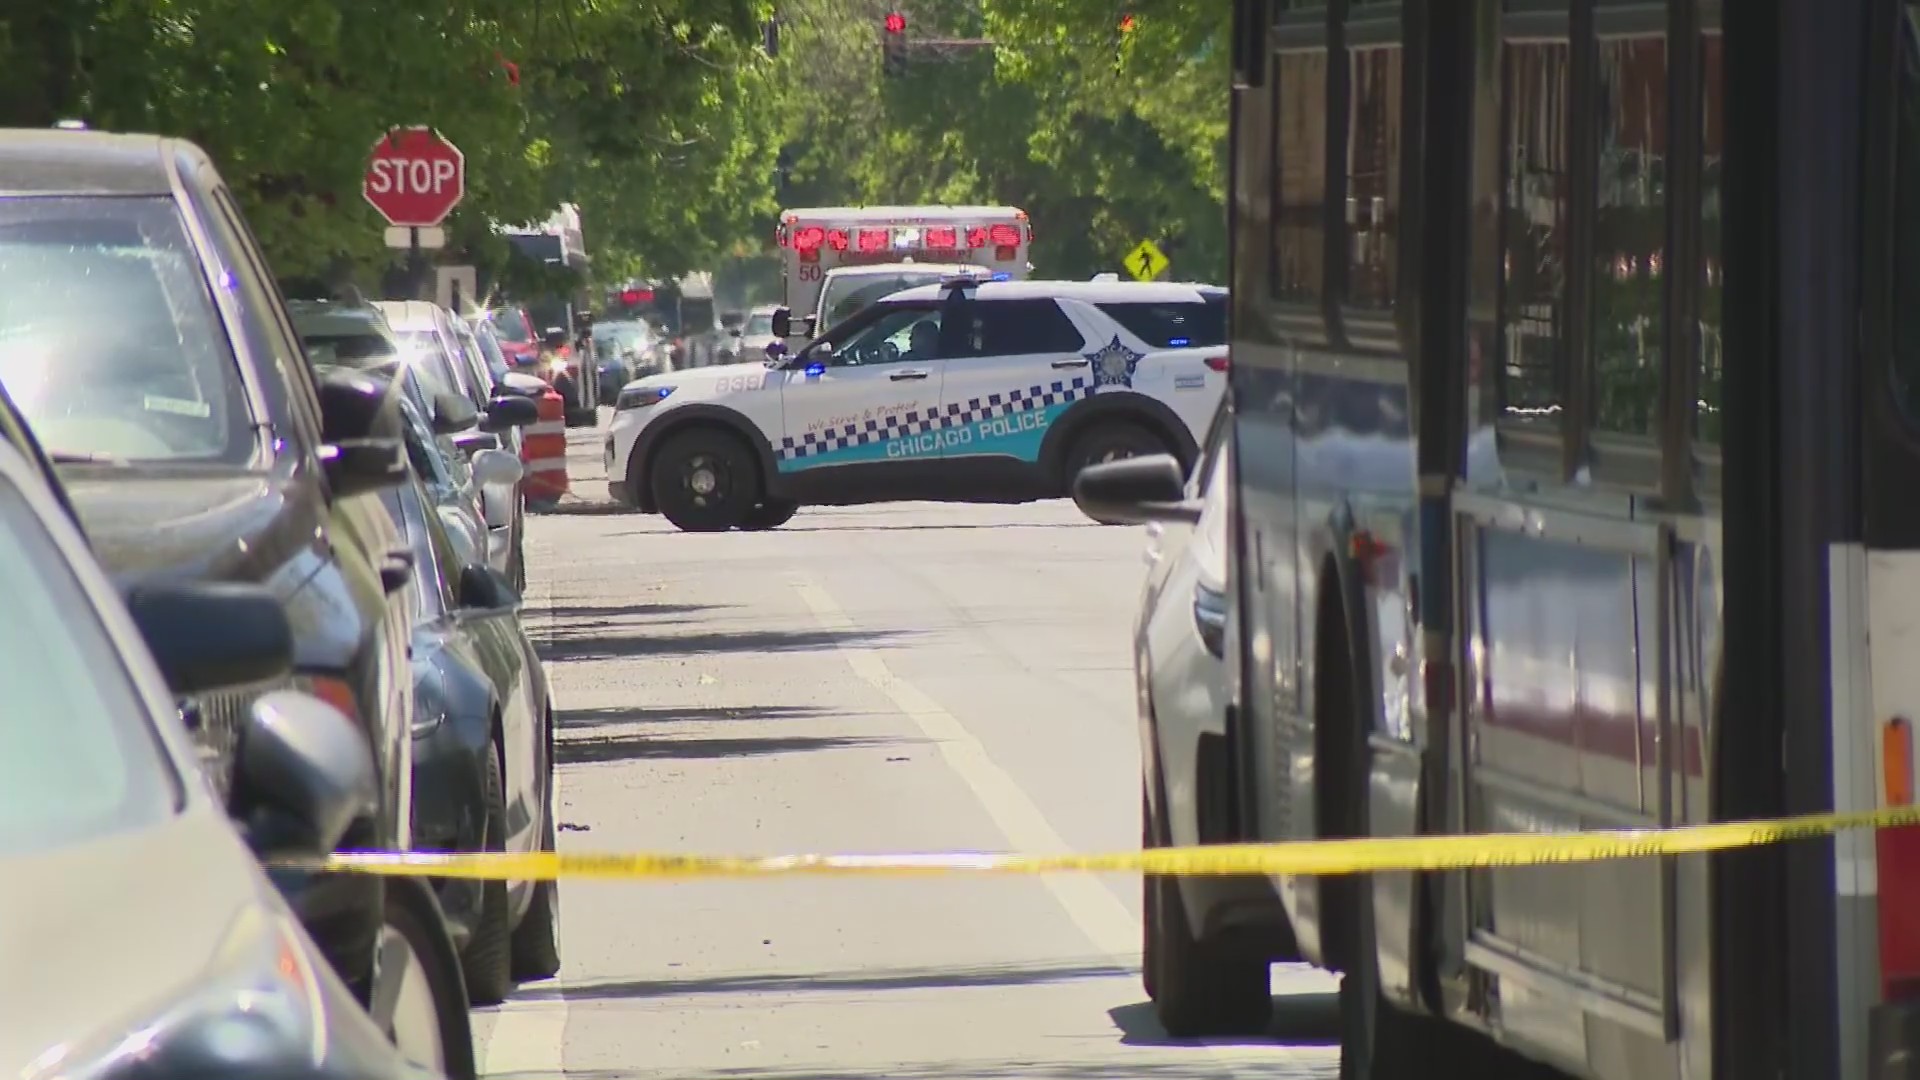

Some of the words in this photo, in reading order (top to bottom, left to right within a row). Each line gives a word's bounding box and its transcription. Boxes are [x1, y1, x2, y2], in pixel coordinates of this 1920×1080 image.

[371, 159, 455, 193] STOP
[799, 266, 821, 282] 50
[828, 414, 857, 426] Serve
[876, 400, 918, 416] Protect
[886, 428, 972, 458] CHICAGO
[979, 410, 1049, 441] POLICE
